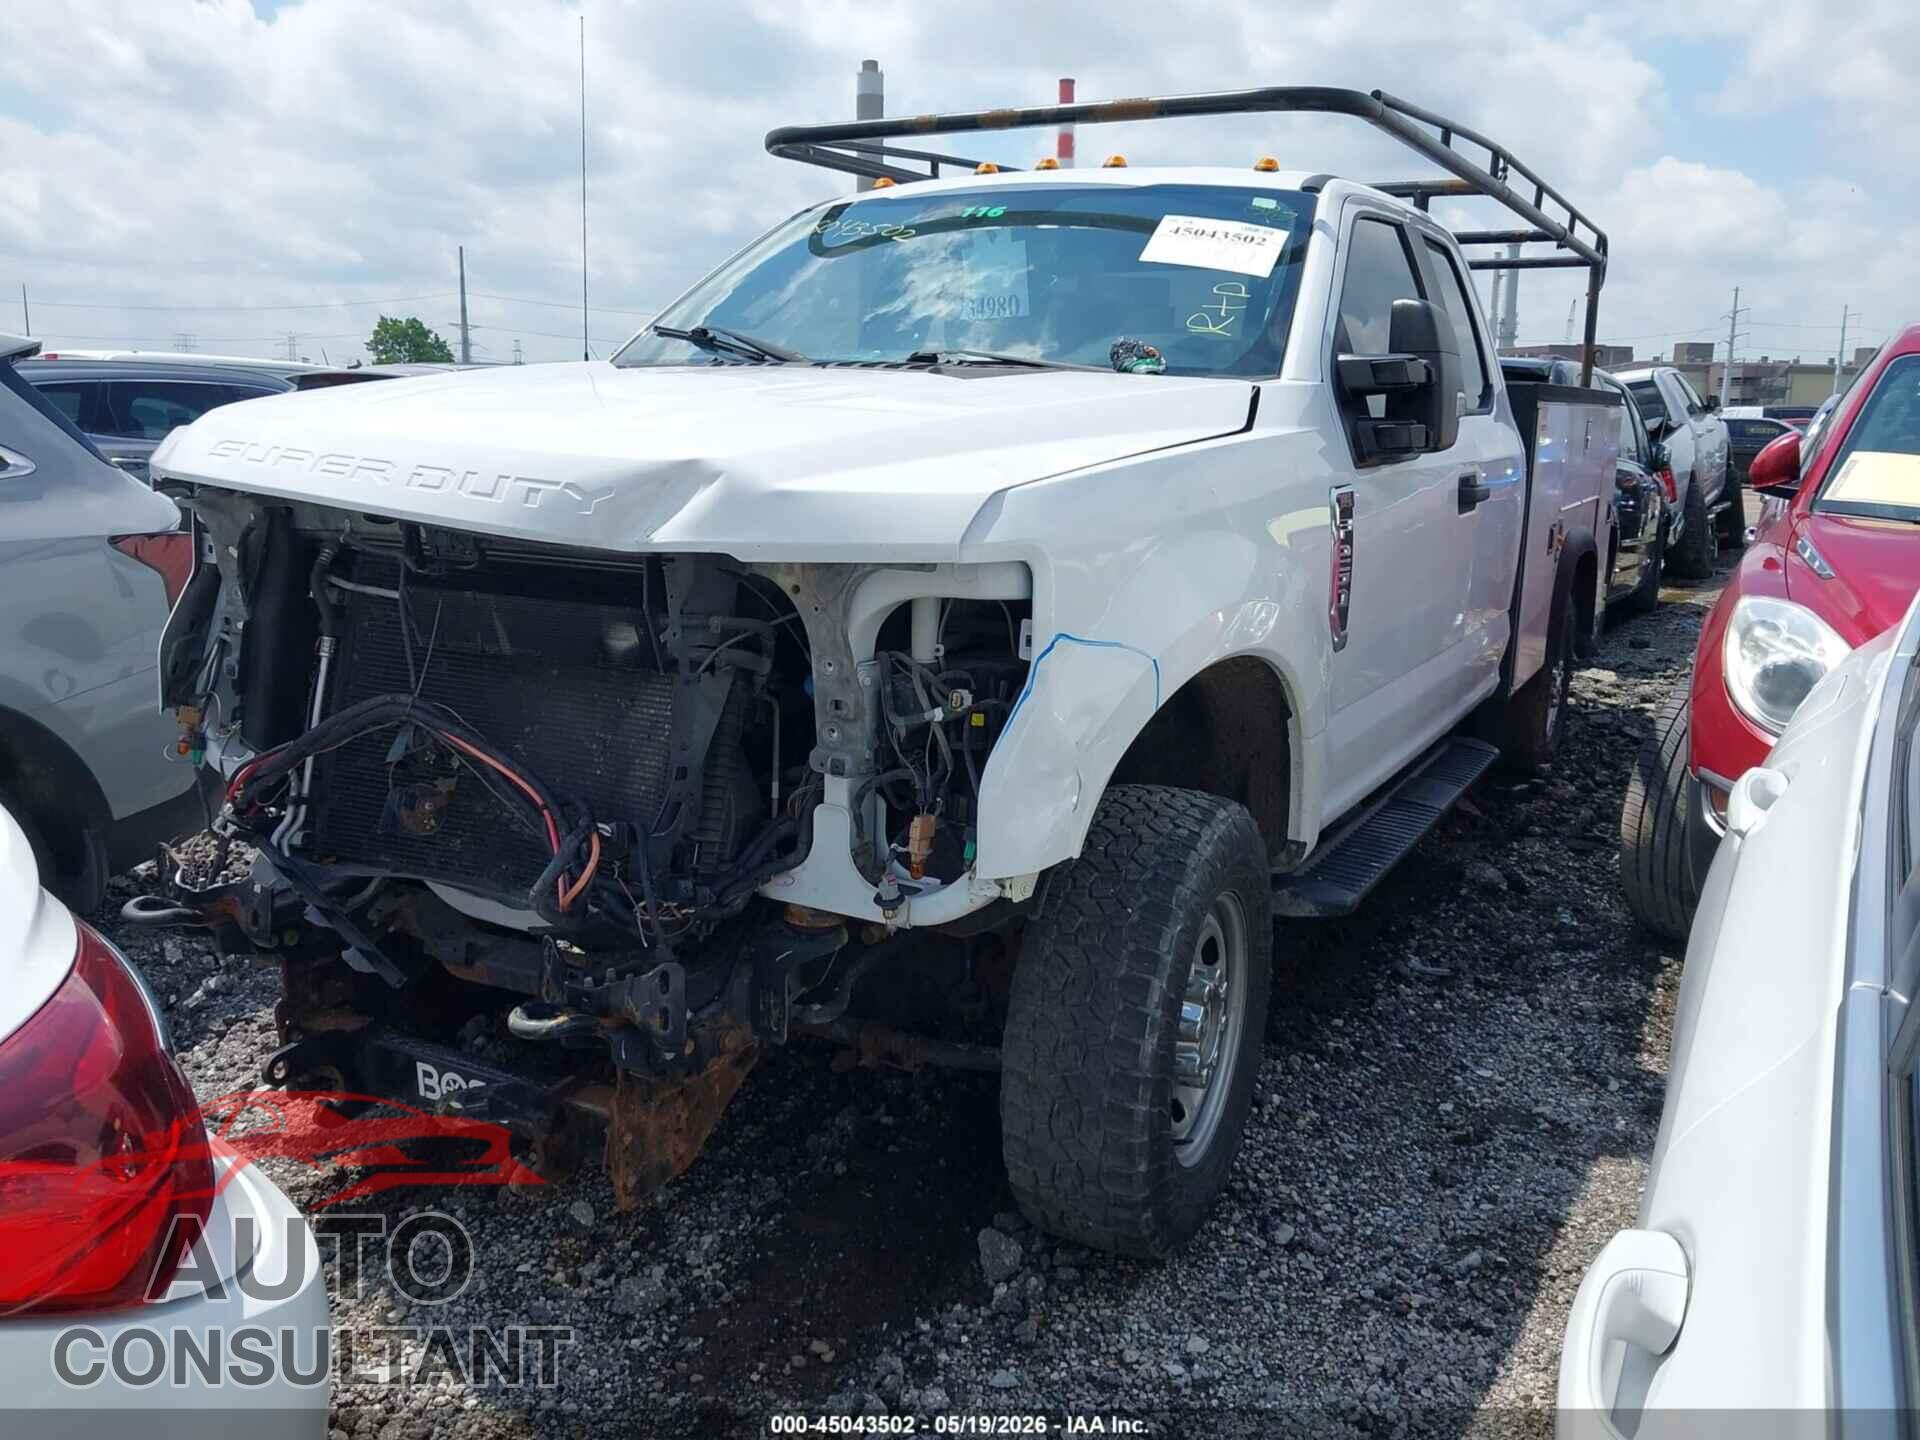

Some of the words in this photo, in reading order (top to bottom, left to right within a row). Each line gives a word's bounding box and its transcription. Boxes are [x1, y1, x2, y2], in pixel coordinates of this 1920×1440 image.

[1169, 226, 1268, 246] 45043502
[209, 439, 399, 485] SUPER
[406, 464, 616, 515] DUTY
